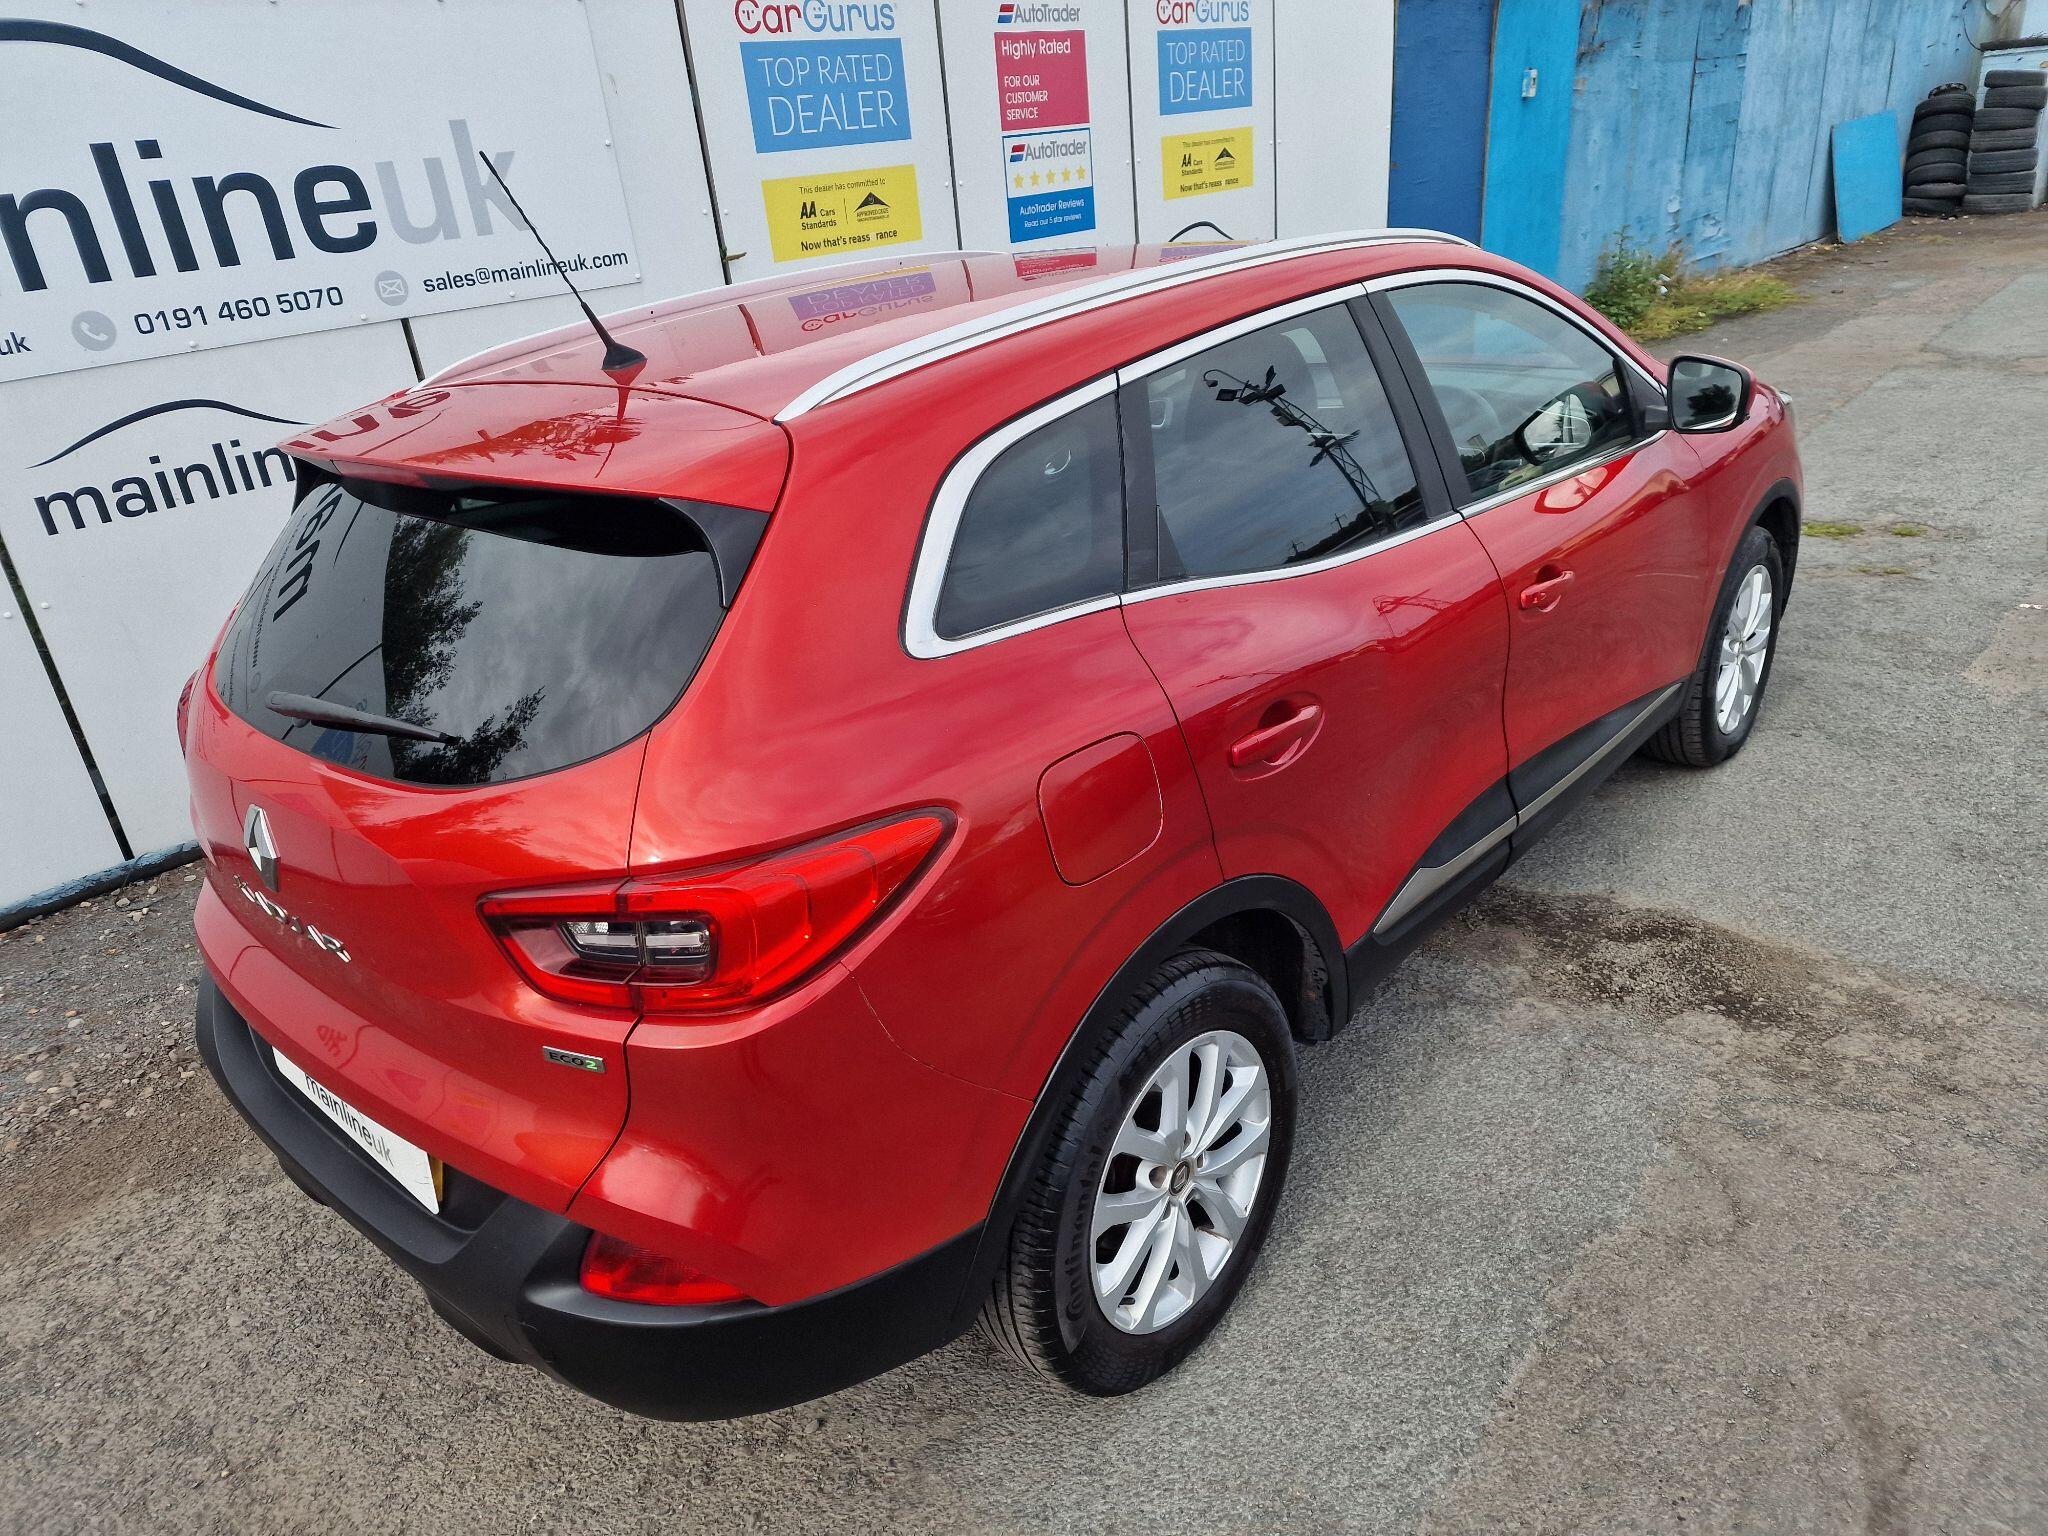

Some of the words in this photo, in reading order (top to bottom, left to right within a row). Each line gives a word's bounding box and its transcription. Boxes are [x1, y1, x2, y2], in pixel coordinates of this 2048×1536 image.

[735, 0, 895, 34] CarGurus
[1014, 4, 1081, 23] AutoTrader
[1157, 0, 1250, 24] CarGurus
[1001, 39, 1036, 59] Highly
[1039, 38, 1071, 54] Rated
[1167, 41, 1197, 65] TOP
[1200, 39, 1246, 64] RATED
[758, 57, 810, 87] TOP
[817, 54, 893, 84] RATED
[1004, 75, 1021, 87] FOR
[1022, 74, 1040, 86] OUR
[1169, 67, 1246, 103] DEALER
[1006, 90, 1048, 104] CUSTOMER
[768, 90, 898, 136] DEALER
[1006, 107, 1039, 121] SERVICE
[1025, 140, 1087, 162] AutoTrader
[1181, 153, 1192, 168] AA
[834, 182, 846, 191] has
[847, 178, 878, 189] committed
[1180, 183, 1193, 192] Now
[1209, 177, 1239, 188] reassrance
[800, 200, 817, 220] AA
[819, 207, 836, 217] Cars
[1020, 202, 1058, 216] AutoTrader
[1058, 198, 1085, 209] Reviews
[801, 217, 837, 231] Standards
[1024, 219, 1040, 228] Read
[801, 240, 822, 252] Now
[822, 235, 847, 247] that's
[849, 228, 898, 244] reassrance
[423, 251, 629, 293] sales@mainlineuk.com
[134, 305, 208, 335] 0191
[218, 296, 271, 322] 460
[276, 286, 344, 314] 5070
[549, 1051, 599, 1071] ECO2
[304, 1071, 395, 1167] mainlineuk
